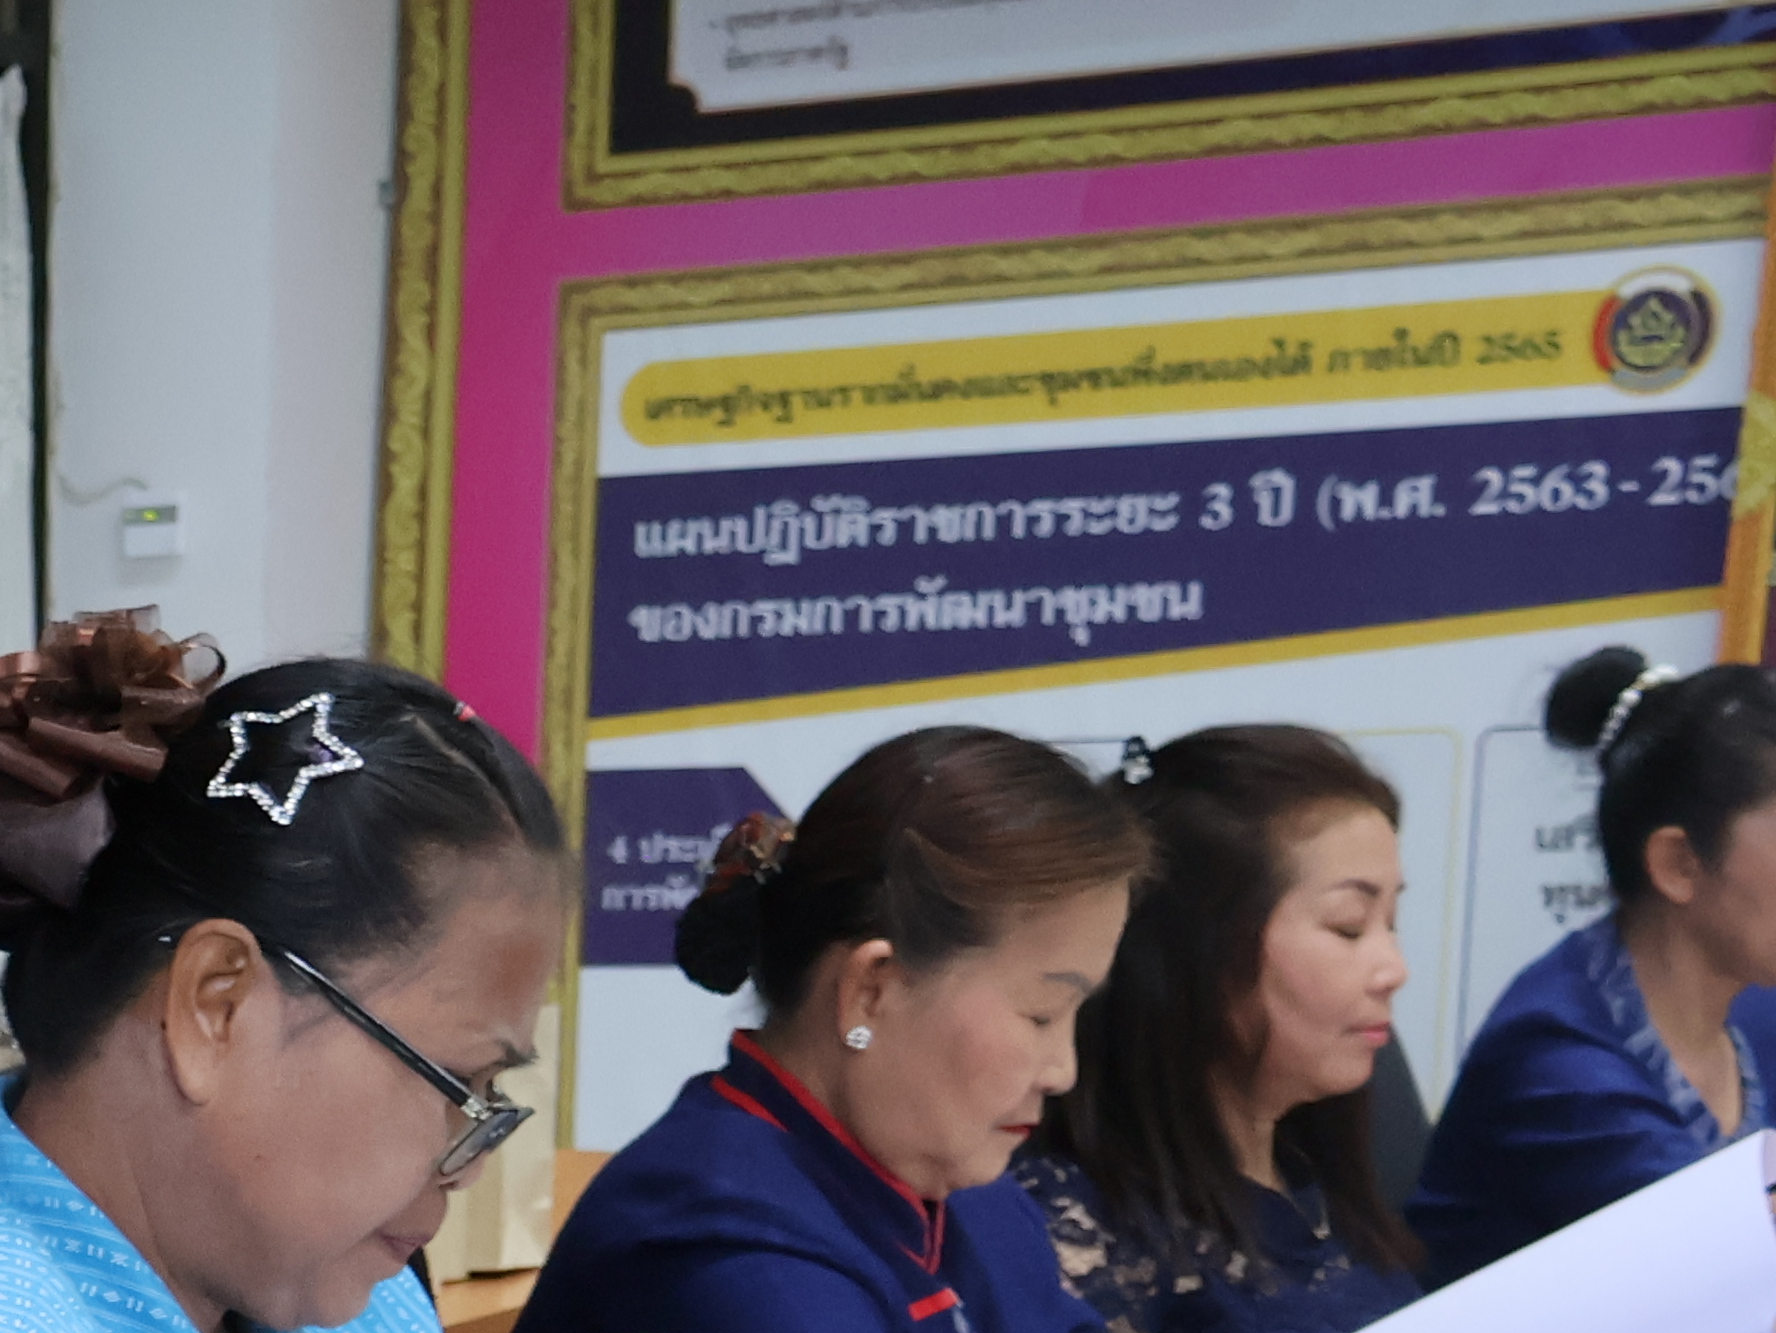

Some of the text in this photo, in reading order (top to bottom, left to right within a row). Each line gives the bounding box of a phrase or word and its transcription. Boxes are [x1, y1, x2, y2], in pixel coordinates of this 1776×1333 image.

[634, 491, 1181, 567] แผนปฏิบัติราชการระยะ
[1199, 482, 1235, 532] 3
[1249, 466, 1298, 530] ปี
[1316, 472, 1446, 533] (พ.ศ.
[626, 575, 1204, 647] ของกรมการพัฒนาชุมชน
